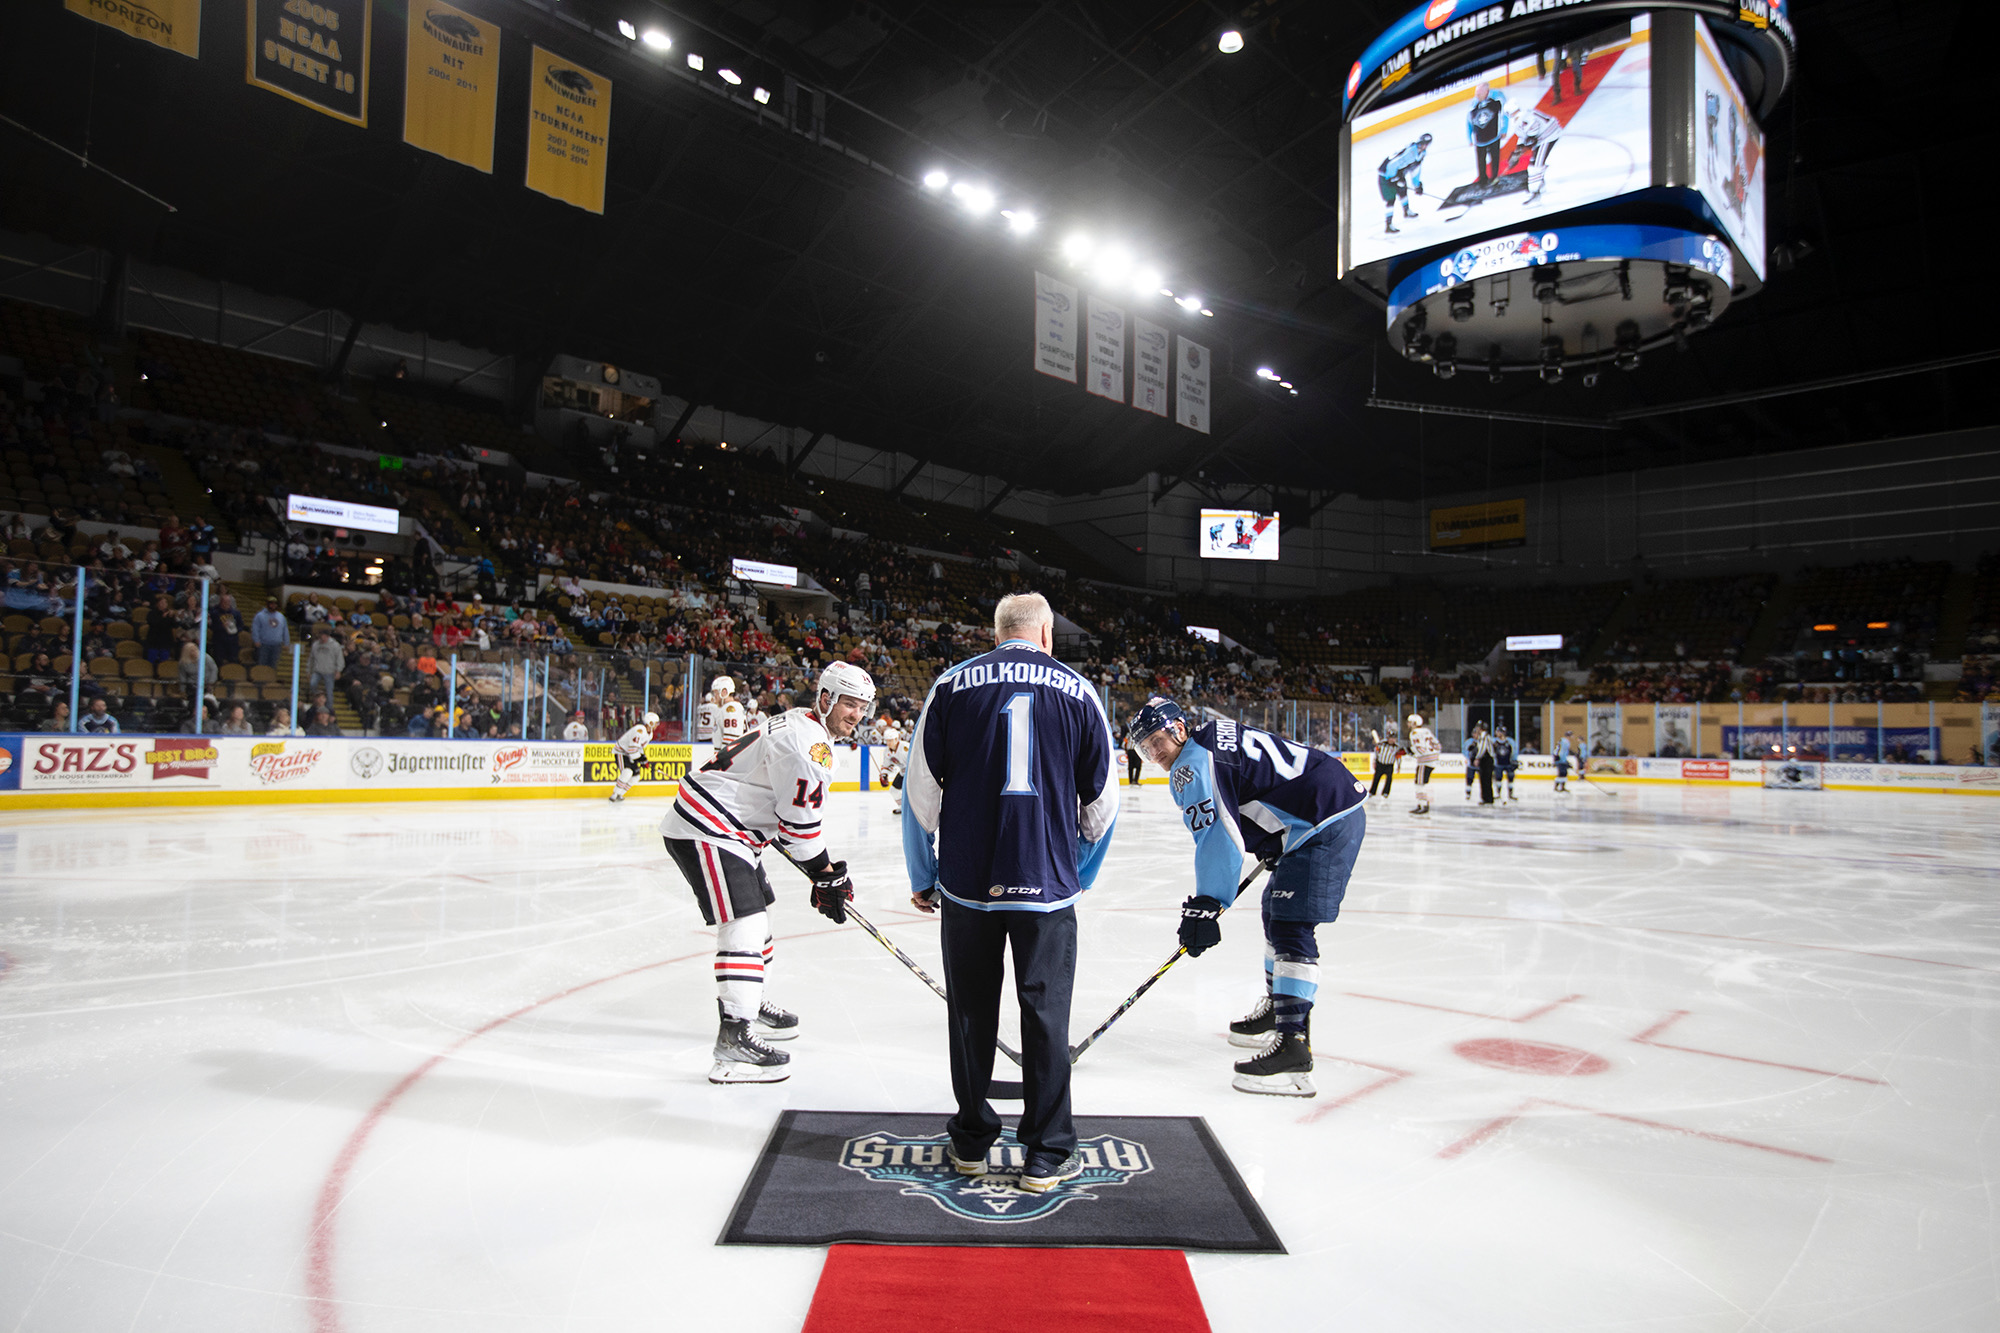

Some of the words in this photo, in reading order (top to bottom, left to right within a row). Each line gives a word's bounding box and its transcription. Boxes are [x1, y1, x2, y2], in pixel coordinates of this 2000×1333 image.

[283, 0, 340, 31] 2005
[280, 17, 342, 62] NCAA
[423, 20, 485, 57] MILWAUKEE
[1381, 47, 1412, 79] UWM
[1414, 5, 1504, 58] PANTHER
[264, 39, 329, 84] SWEET
[442, 53, 465, 71] NIT
[544, 75, 597, 109] MILWAUKEE
[555, 105, 585, 124] NCAA
[533, 110, 605, 147] TOURNAMENT
[1476, 240, 1515, 256] 20:00
[1541, 232, 1559, 252] 0
[1485, 257, 1505, 268] 1ST
[723, 718, 738, 728] 86
[999, 692, 1038, 796] 1
[1805, 730, 1867, 745] LANDING
[33, 743, 138, 774] SAZ'S
[145, 749, 182, 765] BEST
[184, 747, 219, 761] BBQ
[252, 749, 322, 773] Prairie
[532, 750, 581, 758] MILWAUKEE'S
[585, 747, 614, 758] ROBER
[649, 747, 692, 758] DIAMONDS
[264, 766, 310, 781] Farms
[591, 762, 620, 781] CAS
[654, 762, 686, 780] GOLD
[792, 777, 824, 810] 14
[1185, 797, 1217, 832] 25
[1007, 887, 1042, 896] CCM
